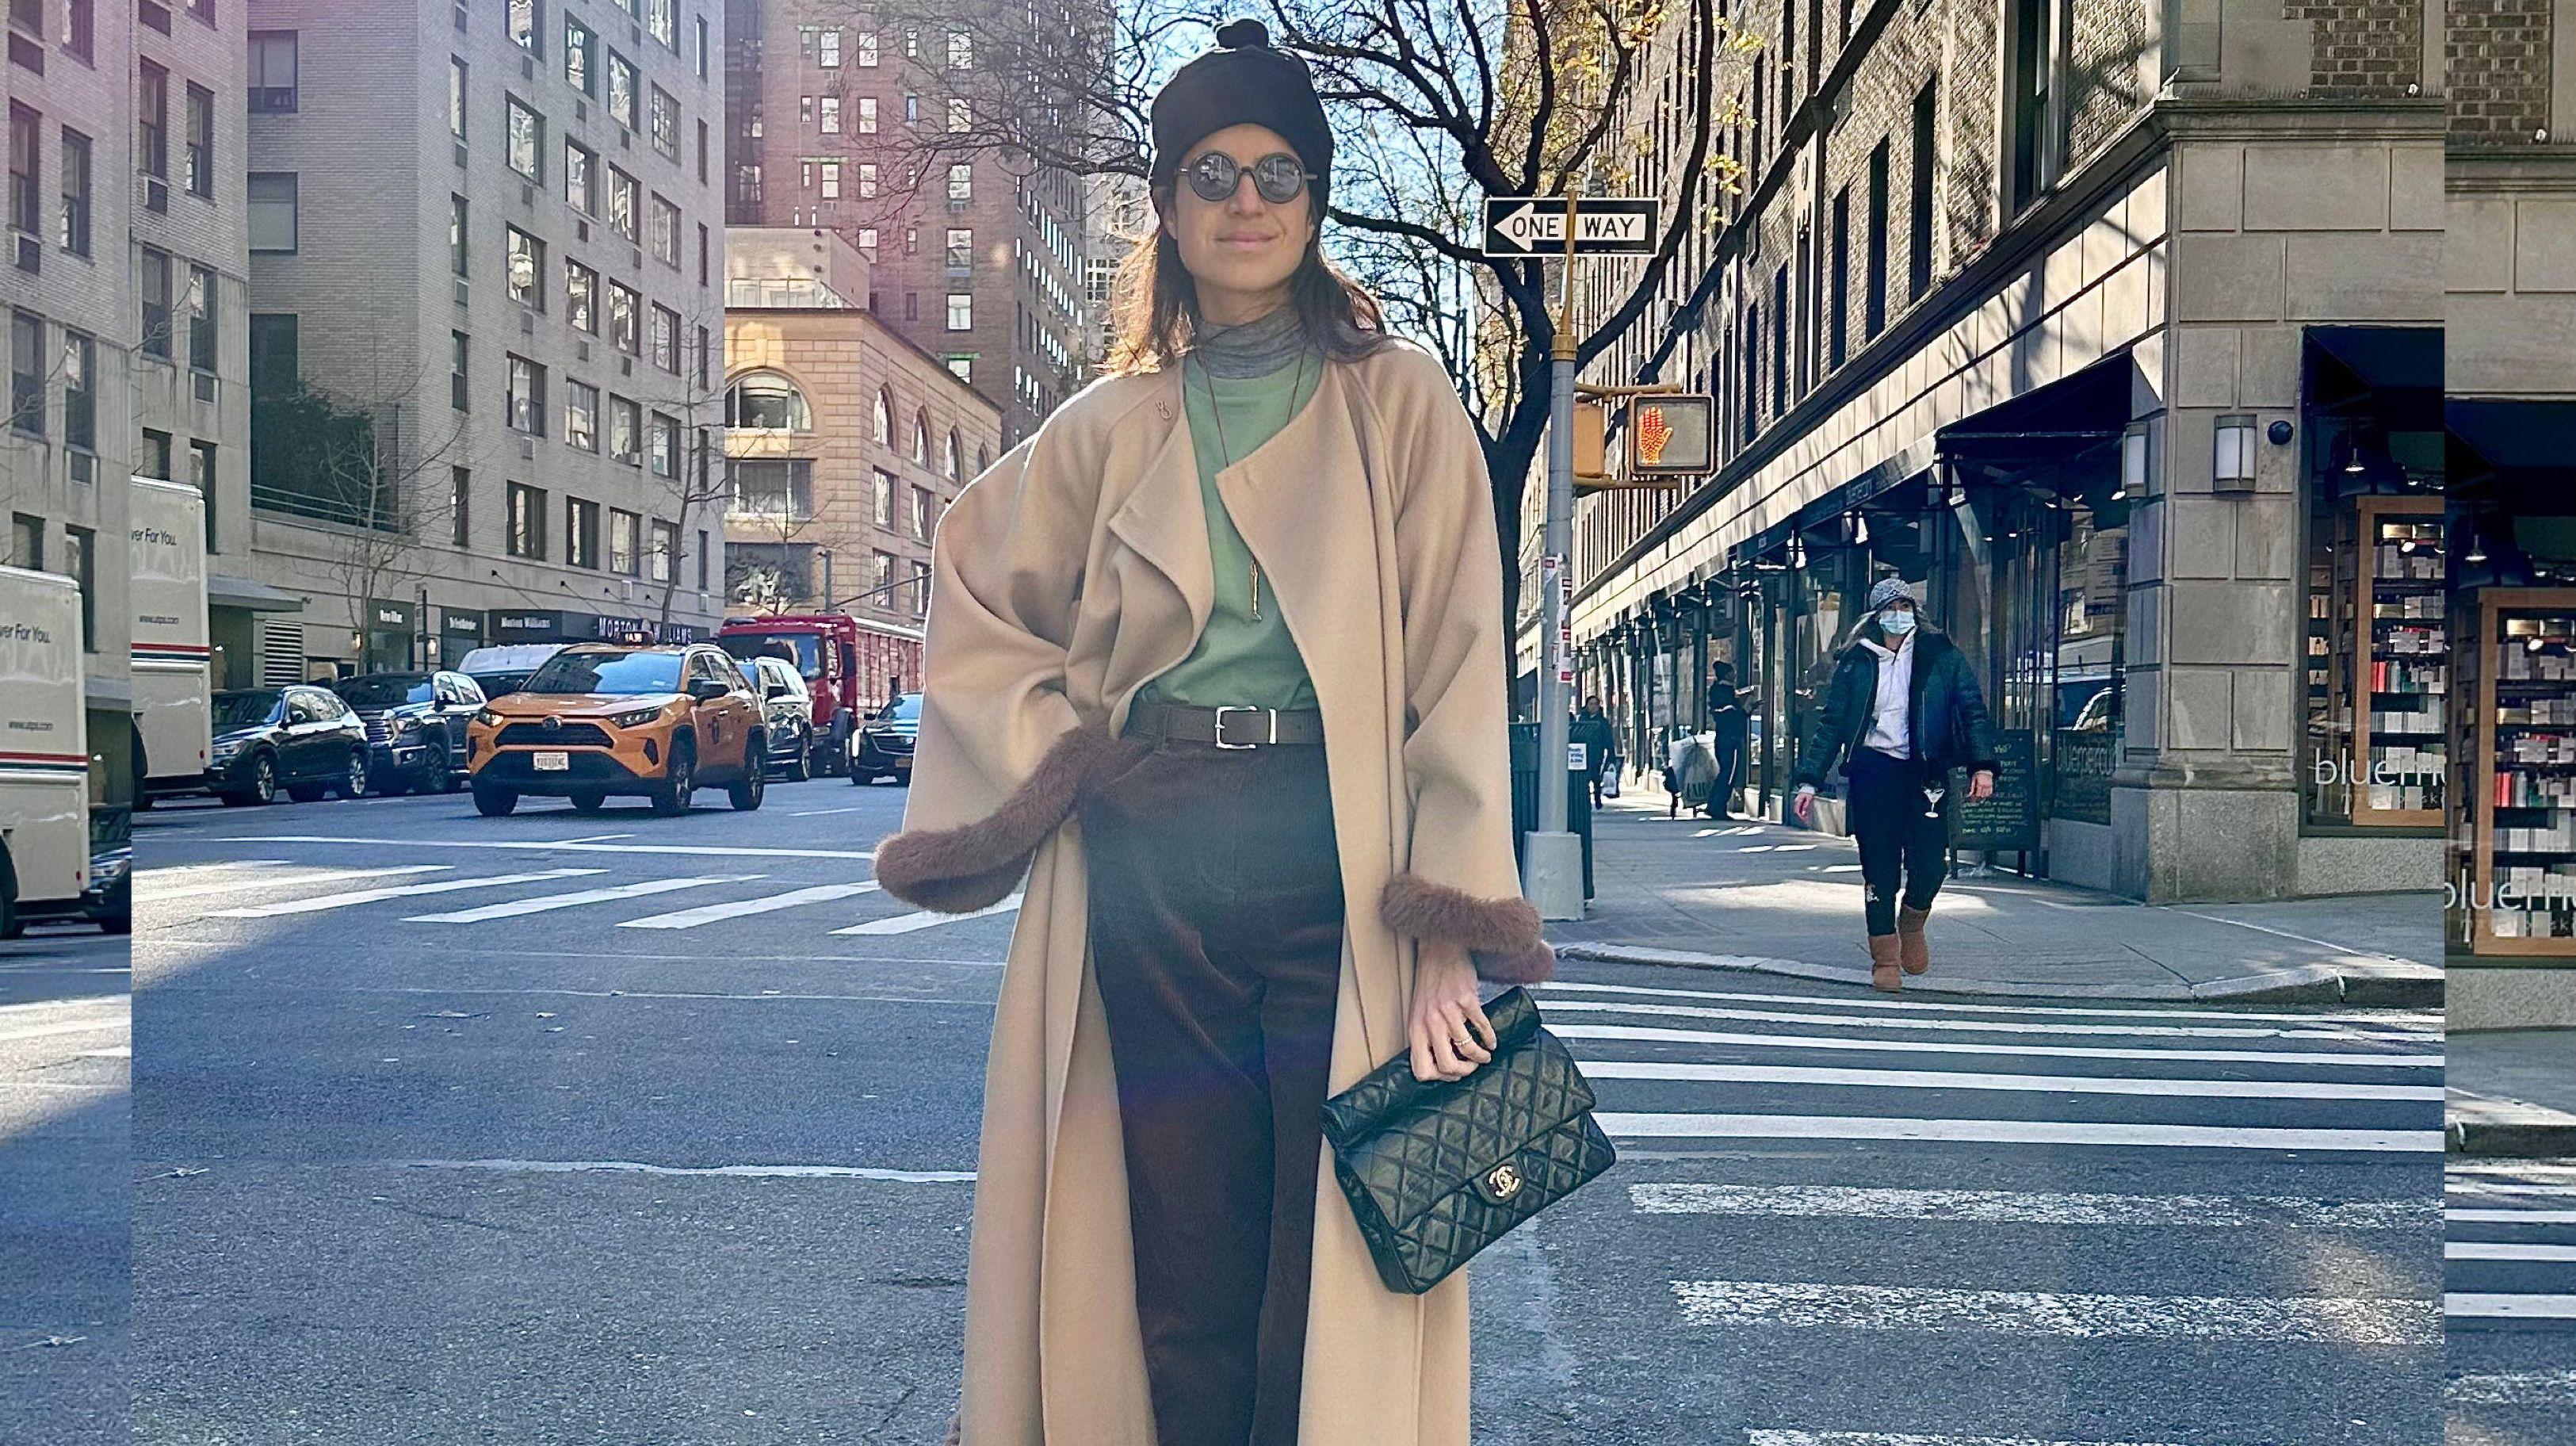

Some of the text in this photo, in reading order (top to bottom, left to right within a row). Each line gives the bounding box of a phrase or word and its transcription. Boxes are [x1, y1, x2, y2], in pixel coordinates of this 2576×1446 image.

[1512, 216, 1635, 238] ONE WAY
[146, 528, 159, 543] For
[15, 623, 31, 640] For
[2314, 748, 2445, 786] bluem
